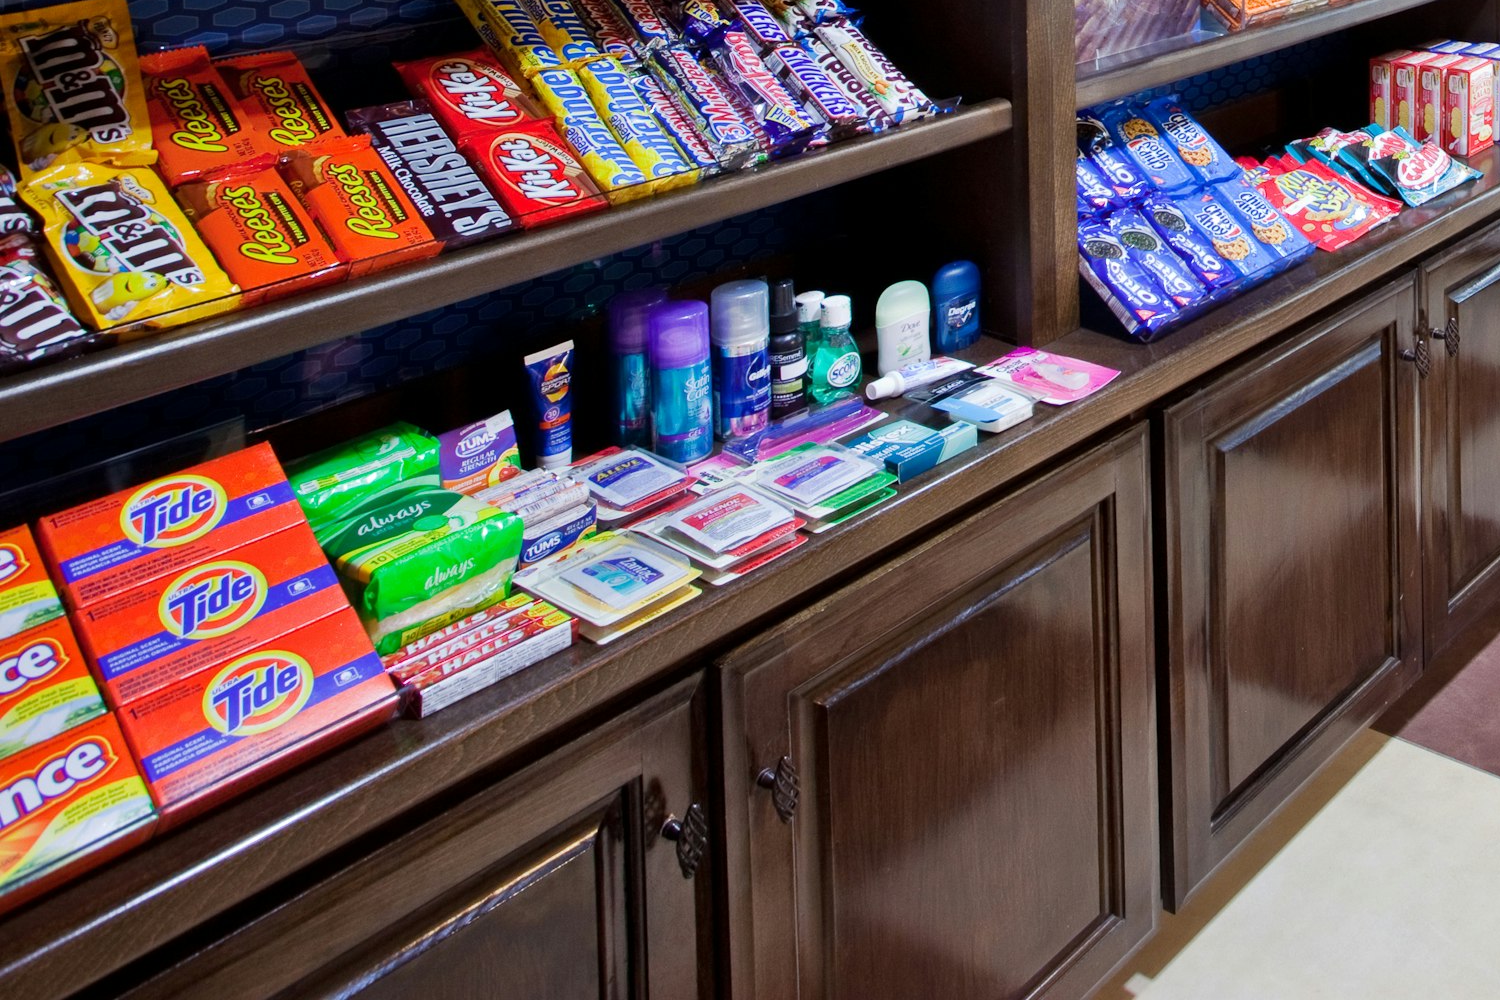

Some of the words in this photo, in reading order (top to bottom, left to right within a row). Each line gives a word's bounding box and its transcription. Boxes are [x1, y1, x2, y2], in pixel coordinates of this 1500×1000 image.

[784, 50, 856, 117] SNICKERS
[586, 60, 686, 177] Butterfinge
[377, 112, 514, 237] HERSHEY'S
[377, 145, 401, 172] Milk
[393, 166, 436, 218] Chocolate
[378, 182, 392, 200] BUTTER
[278, 204, 292, 221] BUTTER
[389, 199, 403, 217] PEANUT
[1238, 191, 1271, 221] Chips
[288, 220, 304, 239] PEANUT
[1177, 233, 1224, 273] OREO
[1107, 258, 1160, 305] OREO
[1145, 253, 1195, 295] OREO
[948, 300, 977, 317] Degree
[901, 319, 921, 334] Dove
[831, 354, 860, 379] SCOPE
[541, 375, 573, 395] SPORT
[683, 374, 711, 393] Satin
[686, 387, 710, 402] Care
[546, 410, 558, 418] 30
[458, 430, 498, 452] TUMS
[687, 428, 703, 438] GEL
[459, 455, 498, 475] STRENGTH
[461, 450, 496, 467] REGULAR
[595, 457, 641, 483] ALEVE
[129, 495, 156, 511] ULTRA
[129, 484, 215, 545] Tide
[696, 497, 741, 520] TYLENOL
[357, 500, 432, 536] always
[69, 551, 100, 568] ORIGINAL
[101, 544, 122, 557] SCENT
[527, 534, 562, 557] TUMS
[71, 558, 98, 573] PARFUM
[99, 548, 129, 563] ORIGINAL
[73, 562, 111, 577] FRAGANCIA
[112, 549, 142, 565] ORIGINAL
[370, 555, 387, 568] 10
[424, 556, 476, 591] always
[618, 555, 658, 582] Zantac
[167, 583, 195, 600] ULTRA
[168, 571, 256, 638] Tide
[405, 611, 488, 656] HALLS
[427, 620, 510, 665] HALLS
[107, 645, 138, 662] ORIGINAL
[139, 637, 162, 650] SCENT
[109, 653, 136, 669] PARFUM
[137, 640, 168, 656] ORIGINAL
[111, 656, 150, 673] FRAGANCIA
[151, 642, 182, 659] ORIGINAL
[443, 630, 525, 675] HALLS
[211, 676, 239, 695] ULTRA
[211, 662, 300, 734] Tide
[152, 744, 183, 764] ORIGINAL
[184, 734, 206, 748] SCENT
[154, 752, 180, 769] PARFUM
[181, 738, 214, 757] ORIGINAL
[156, 755, 194, 775] FRAGANCIA
[195, 738, 228, 758] ORIGINAL
[0, 741, 106, 828] nce
